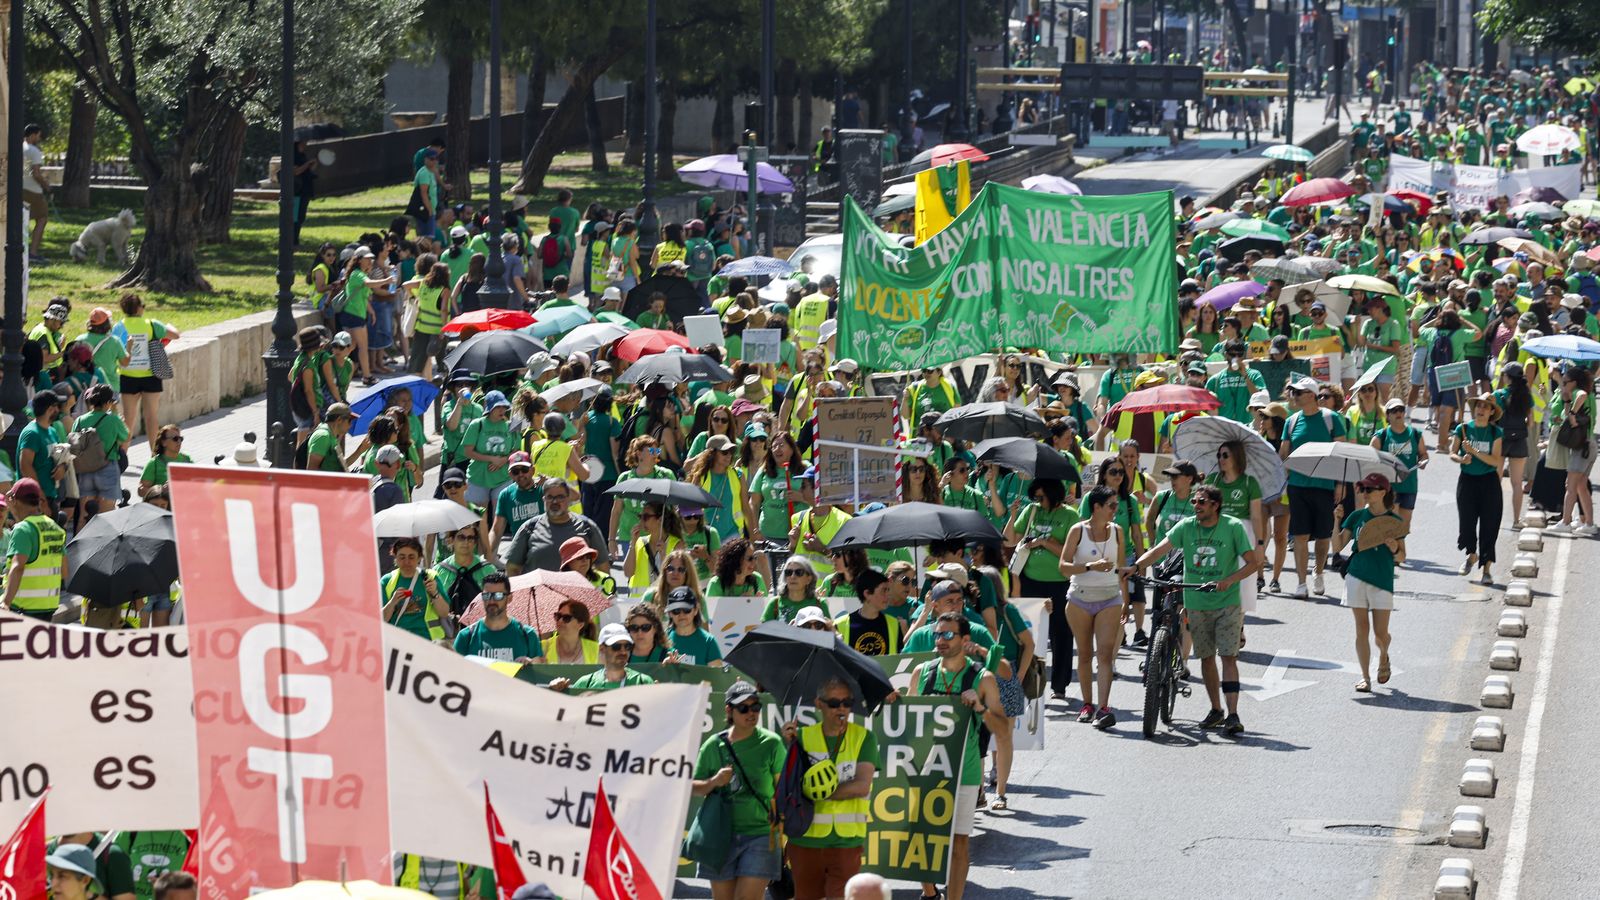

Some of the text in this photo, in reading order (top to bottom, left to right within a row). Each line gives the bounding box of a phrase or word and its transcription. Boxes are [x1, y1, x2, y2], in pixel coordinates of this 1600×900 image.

[998, 204, 1015, 238] A
[1026, 198, 1151, 248] VALÈNCIA
[1001, 256, 1134, 301] NOSALTRES
[858, 429, 873, 443] 27
[830, 452, 890, 477] EDUACIÓ
[859, 640, 882, 655] SOS
[224, 498, 334, 864] UGT
[91, 689, 154, 723] es
[94, 754, 156, 790] es
[480, 729, 694, 780] Ausiàs March
